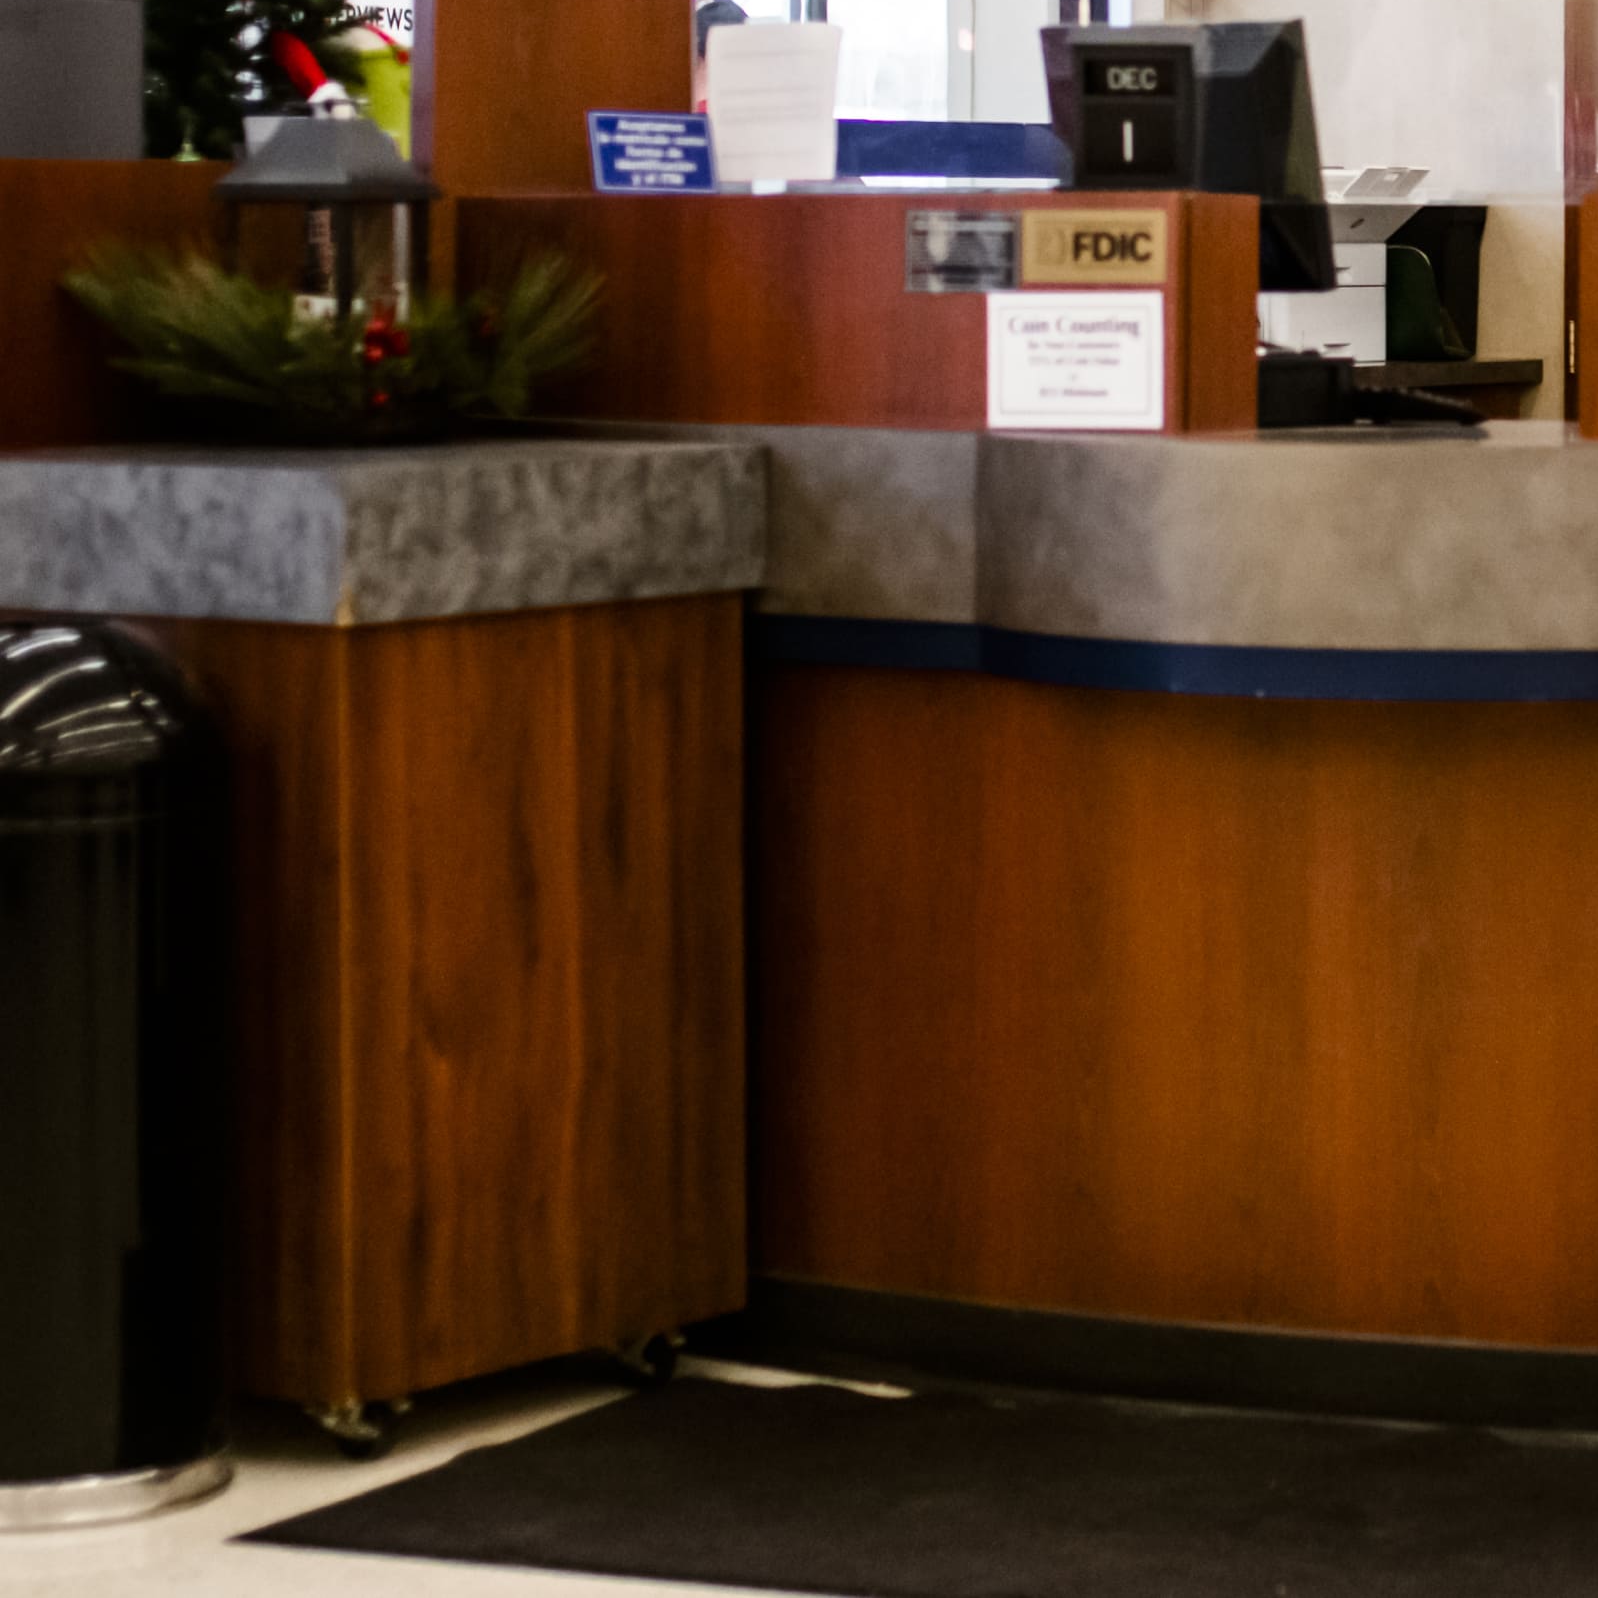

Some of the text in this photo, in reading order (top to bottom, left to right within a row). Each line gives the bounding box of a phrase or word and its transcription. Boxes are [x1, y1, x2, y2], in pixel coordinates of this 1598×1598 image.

[1106, 67, 1157, 90] DEC
[1072, 230, 1152, 263] FDIC
[1055, 314, 1140, 339] Counting
